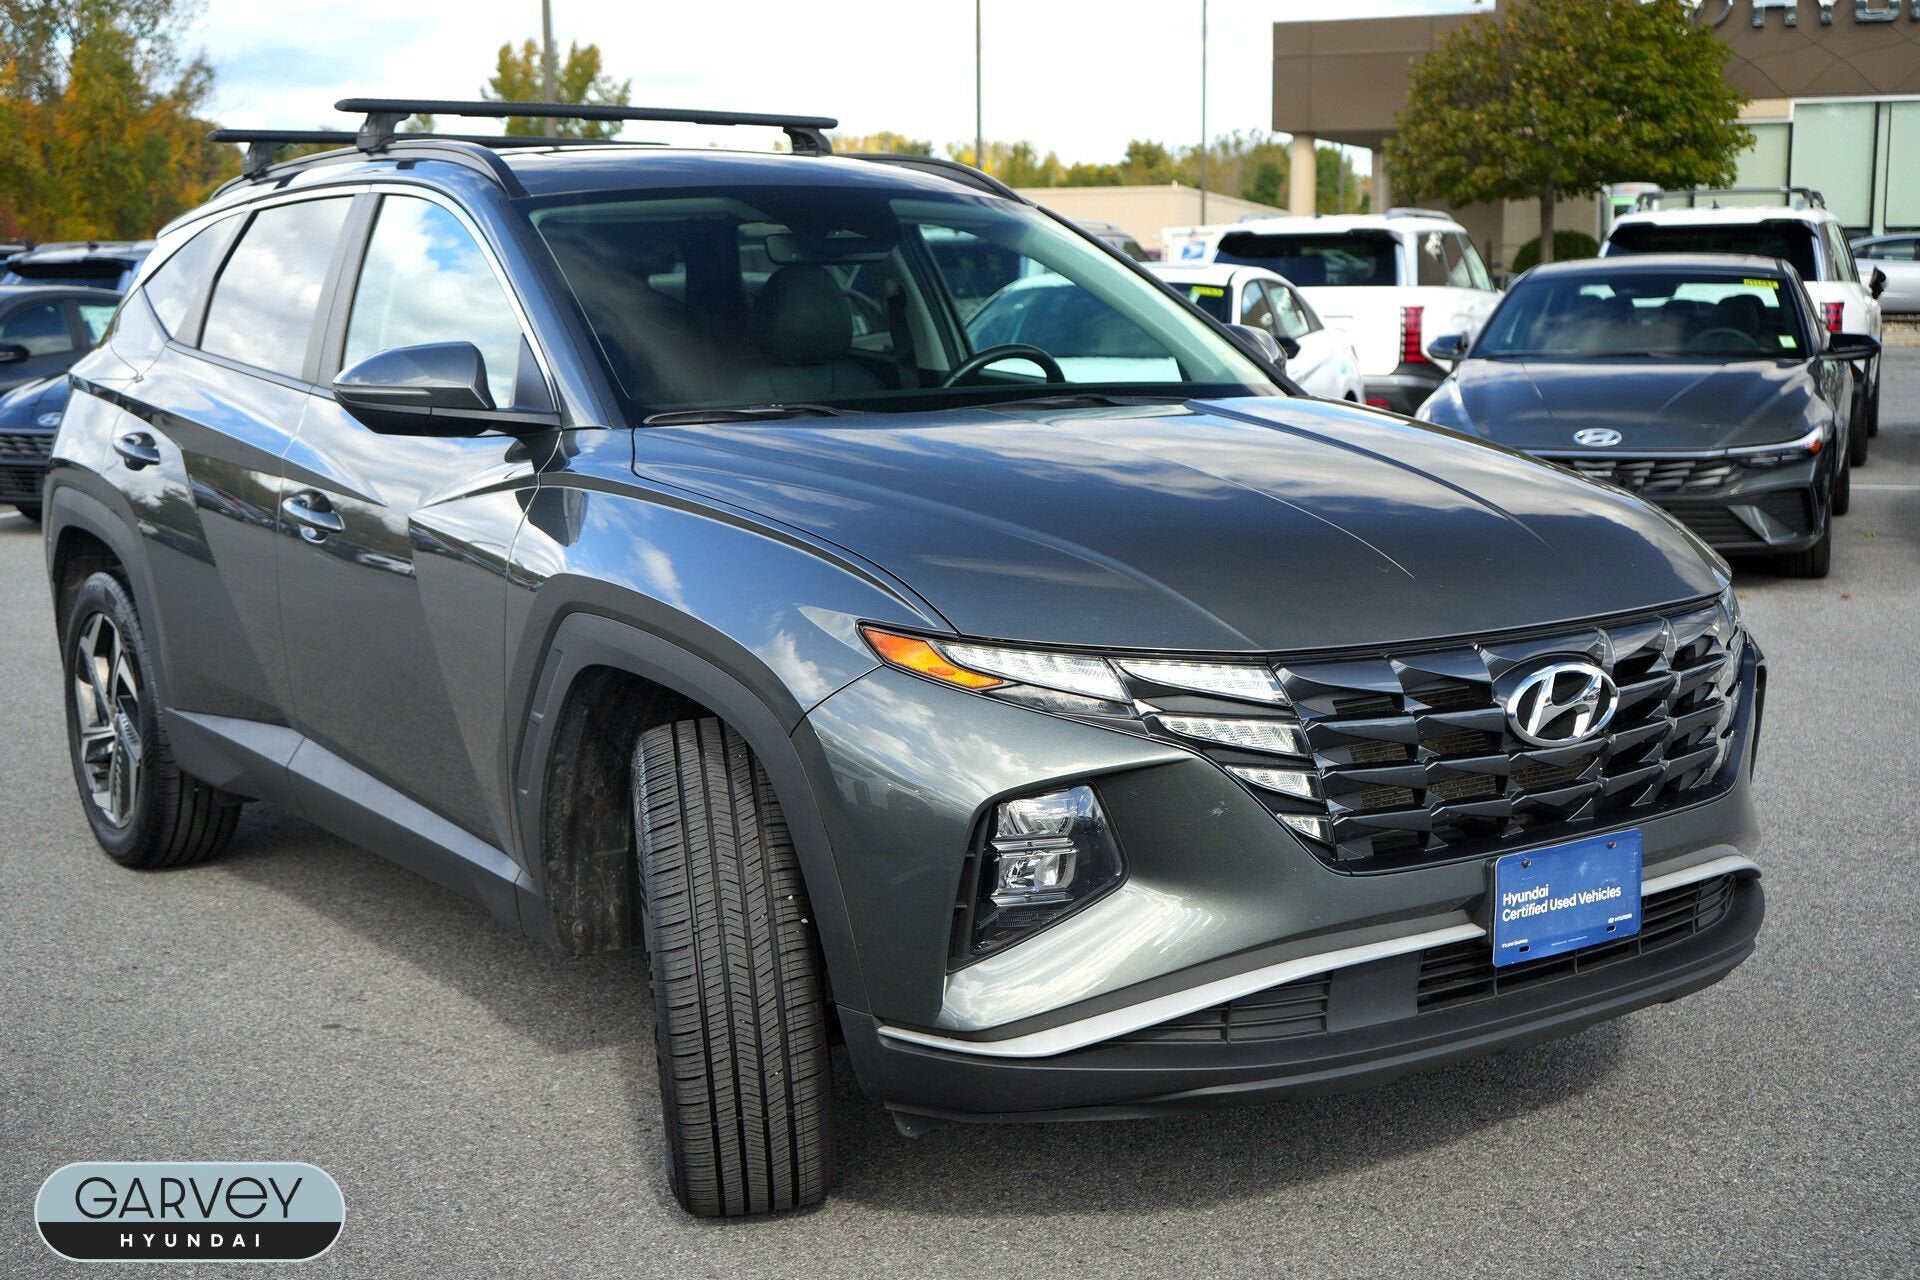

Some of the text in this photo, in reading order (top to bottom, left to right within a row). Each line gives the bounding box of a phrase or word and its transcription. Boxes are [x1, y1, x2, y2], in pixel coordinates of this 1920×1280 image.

[1502, 886, 1622, 922] Certified Used Vehicles
[1503, 884, 1549, 906] Hyundai
